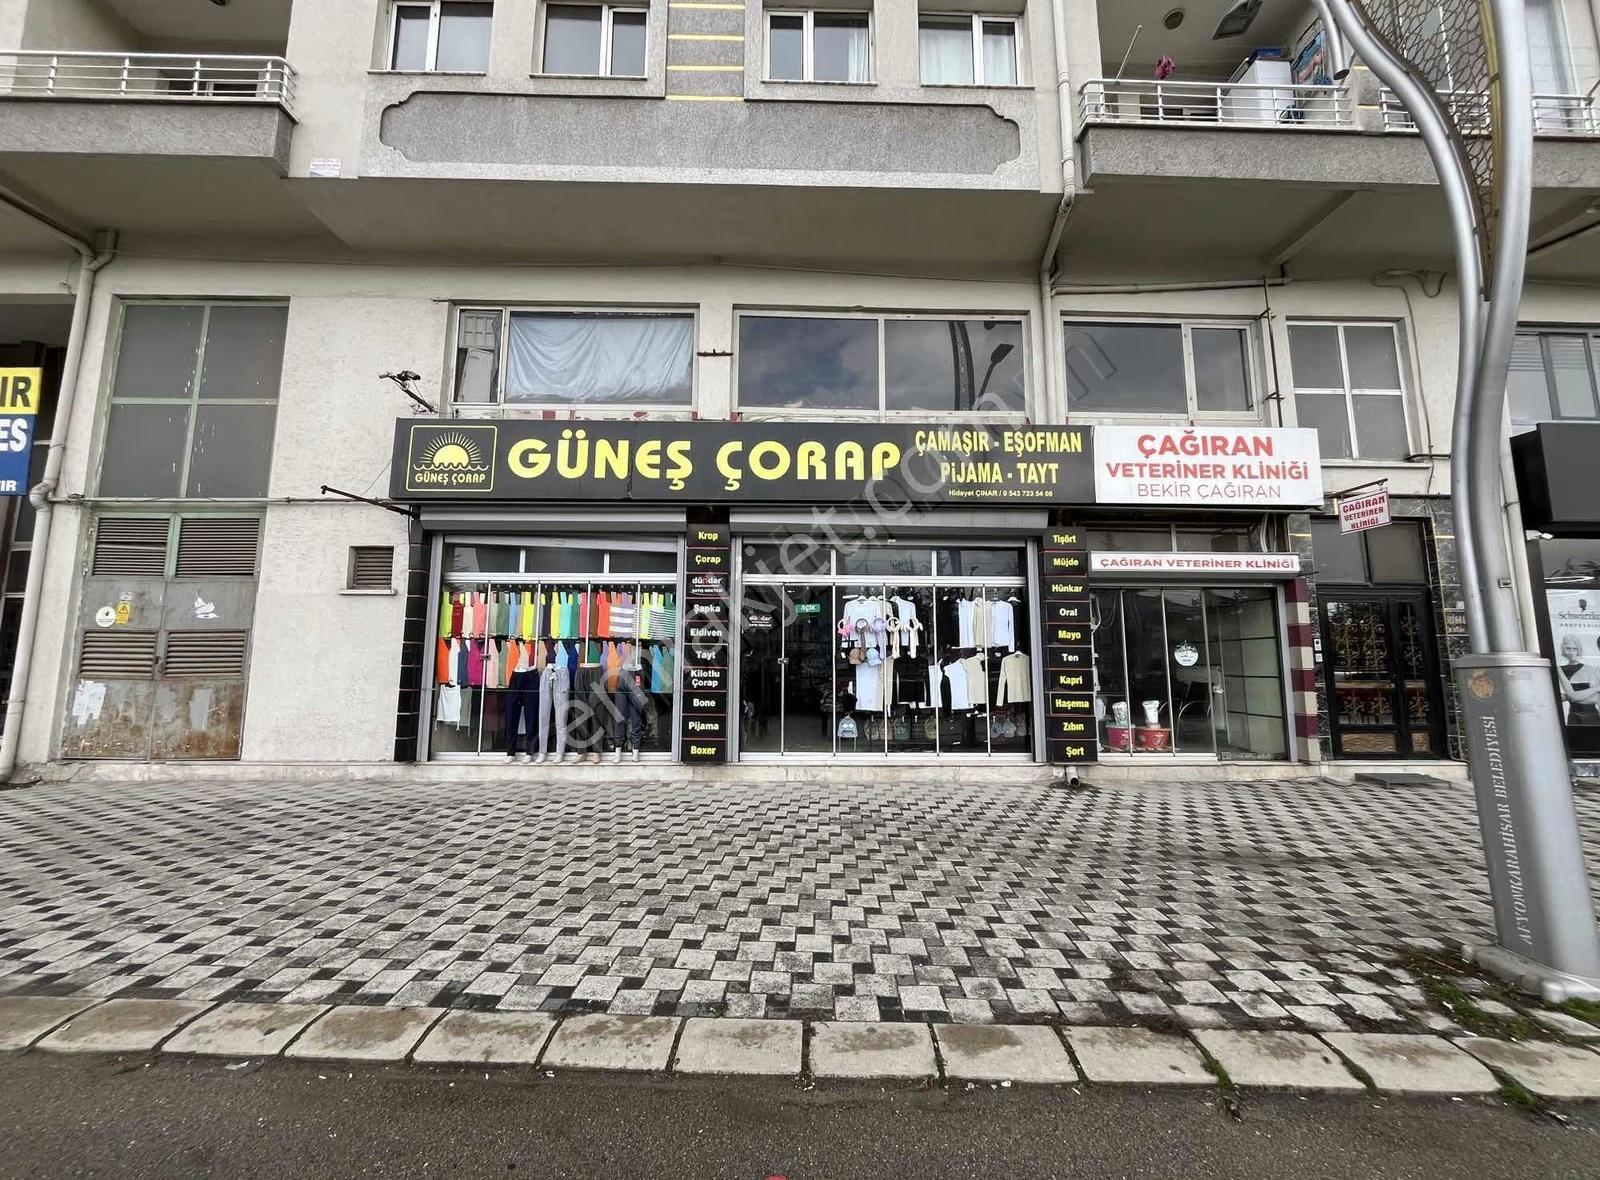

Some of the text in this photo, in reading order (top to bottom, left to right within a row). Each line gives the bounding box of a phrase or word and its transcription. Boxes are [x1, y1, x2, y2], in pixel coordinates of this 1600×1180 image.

[915, 430, 990, 456] ÇAMAŞIR
[1003, 431, 1082, 457] EŞOFMAN
[1137, 429, 1274, 459] ÇAĞIRAN
[507, 428, 901, 491] GÜNEŞ ÇORAP
[1017, 463, 1059, 484] TAYT
[1106, 460, 1309, 480] VETERİNER KLİNİĞİ
[415, 471, 486, 486] GÜNEŞ ÇORAP
[1137, 481, 1281, 500] BEKİR ÇAĞIRAN
[698, 531, 719, 541] Krop
[1052, 534, 1077, 545] Tişört
[695, 554, 721, 566] Çorap
[1053, 557, 1079, 567] Müjde
[1100, 556, 1295, 570] ÇAĞIRAN VETERİNER KLİNİĞİ
[1051, 583, 1083, 593] Hünkar
[693, 604, 721, 614] Şapka
[1059, 607, 1078, 617] Oral
[690, 628, 723, 637] Eldiven
[1058, 630, 1081, 640] Mayo
[695, 650, 716, 660] Tayt
[1061, 653, 1079, 662] Ten
[690, 669, 720, 678] Kilotlu
[692, 678, 719, 688] Çorap
[1059, 675, 1083, 685] Kapri
[693, 698, 716, 707] Bone
[1055, 698, 1090, 710] Haşema
[688, 721, 719, 731] Pijama
[1063, 722, 1085, 731] Zıbın
[690, 745, 716, 755] Boxer
[1066, 746, 1085, 758] Şort
